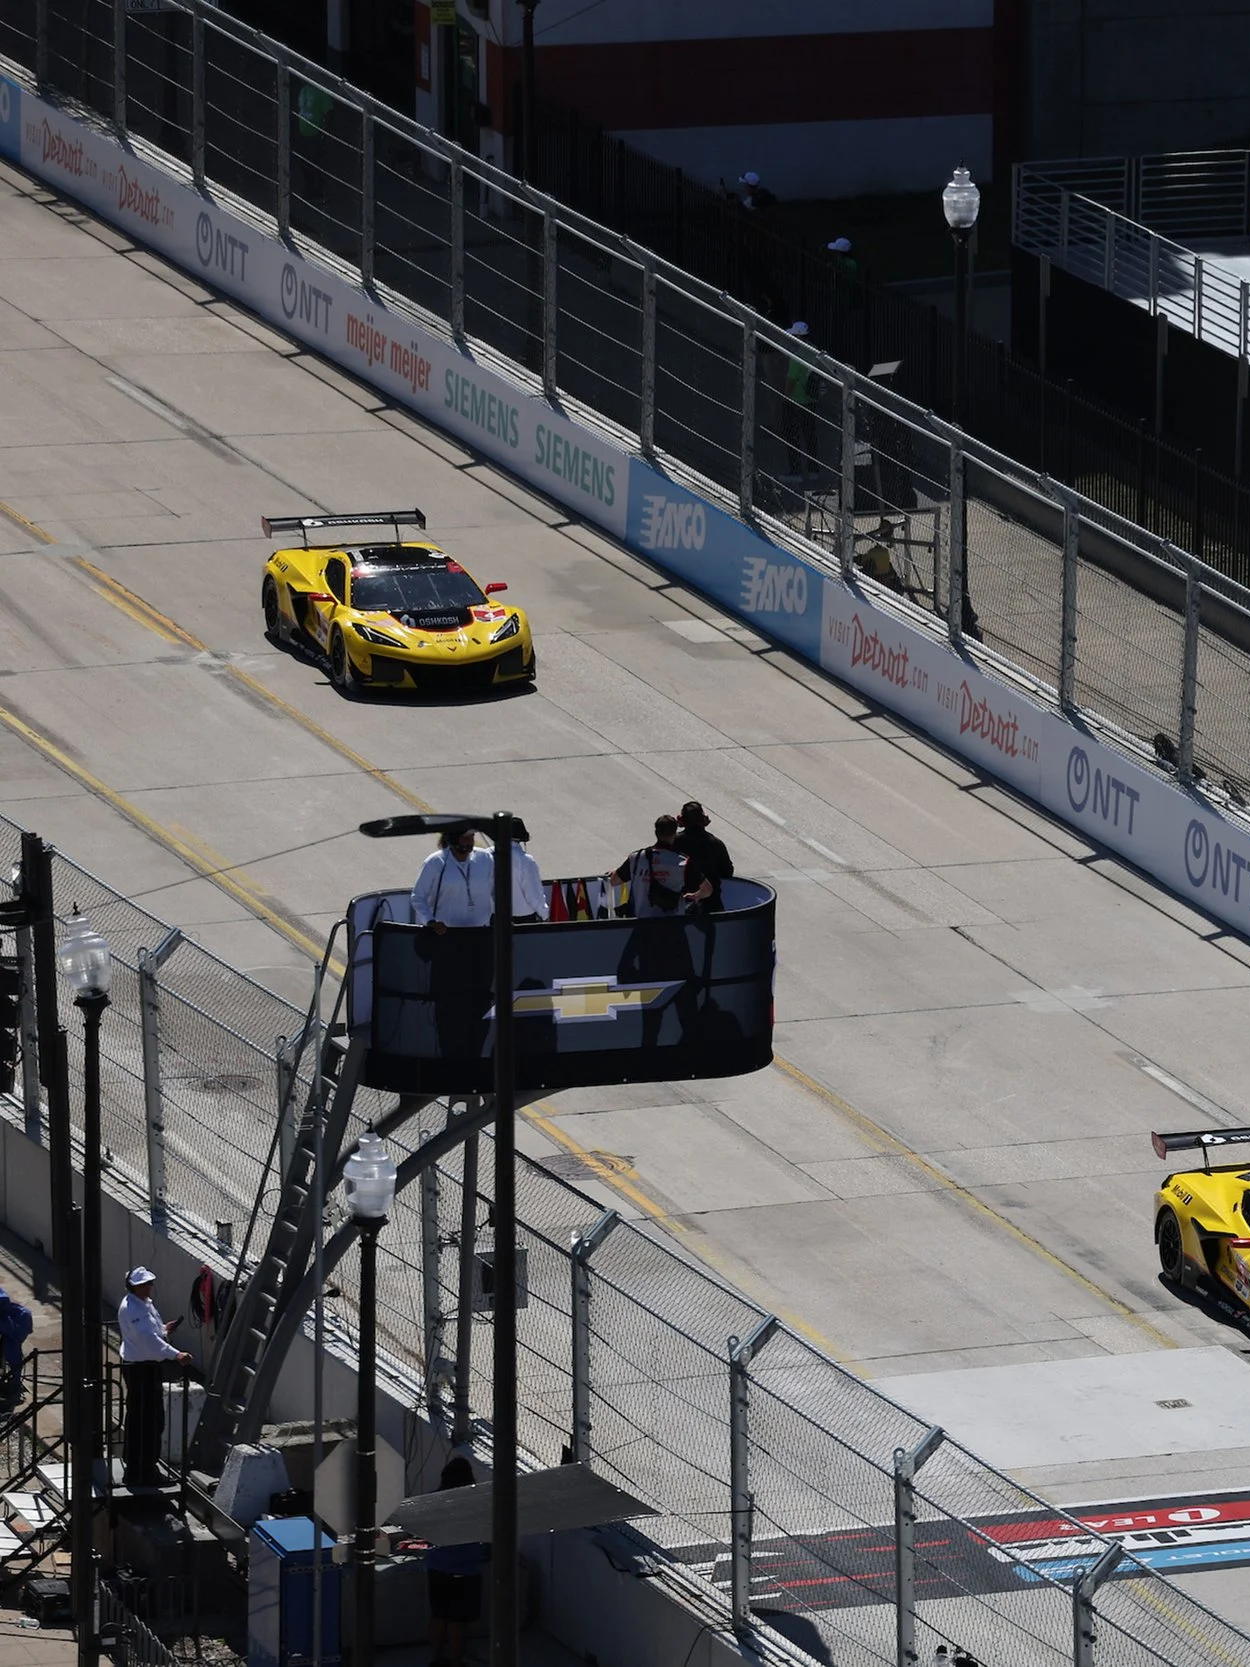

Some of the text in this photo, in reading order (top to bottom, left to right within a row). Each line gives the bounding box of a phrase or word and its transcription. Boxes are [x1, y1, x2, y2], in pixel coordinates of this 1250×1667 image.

[215, 228, 249, 282] NTT
[300, 281, 333, 335] NTT
[346, 312, 433, 394] meijer meijer
[444, 368, 519, 449] SIEMENS
[535, 424, 615, 508] SIEMENS
[639, 495, 706, 551] FAYGO
[739, 556, 807, 616] FAYGO
[418, 615, 460, 627] OSHKOSH
[829, 615, 850, 647] VISIT
[937, 680, 959, 713] VISIT
[1093, 767, 1140, 835] NTT
